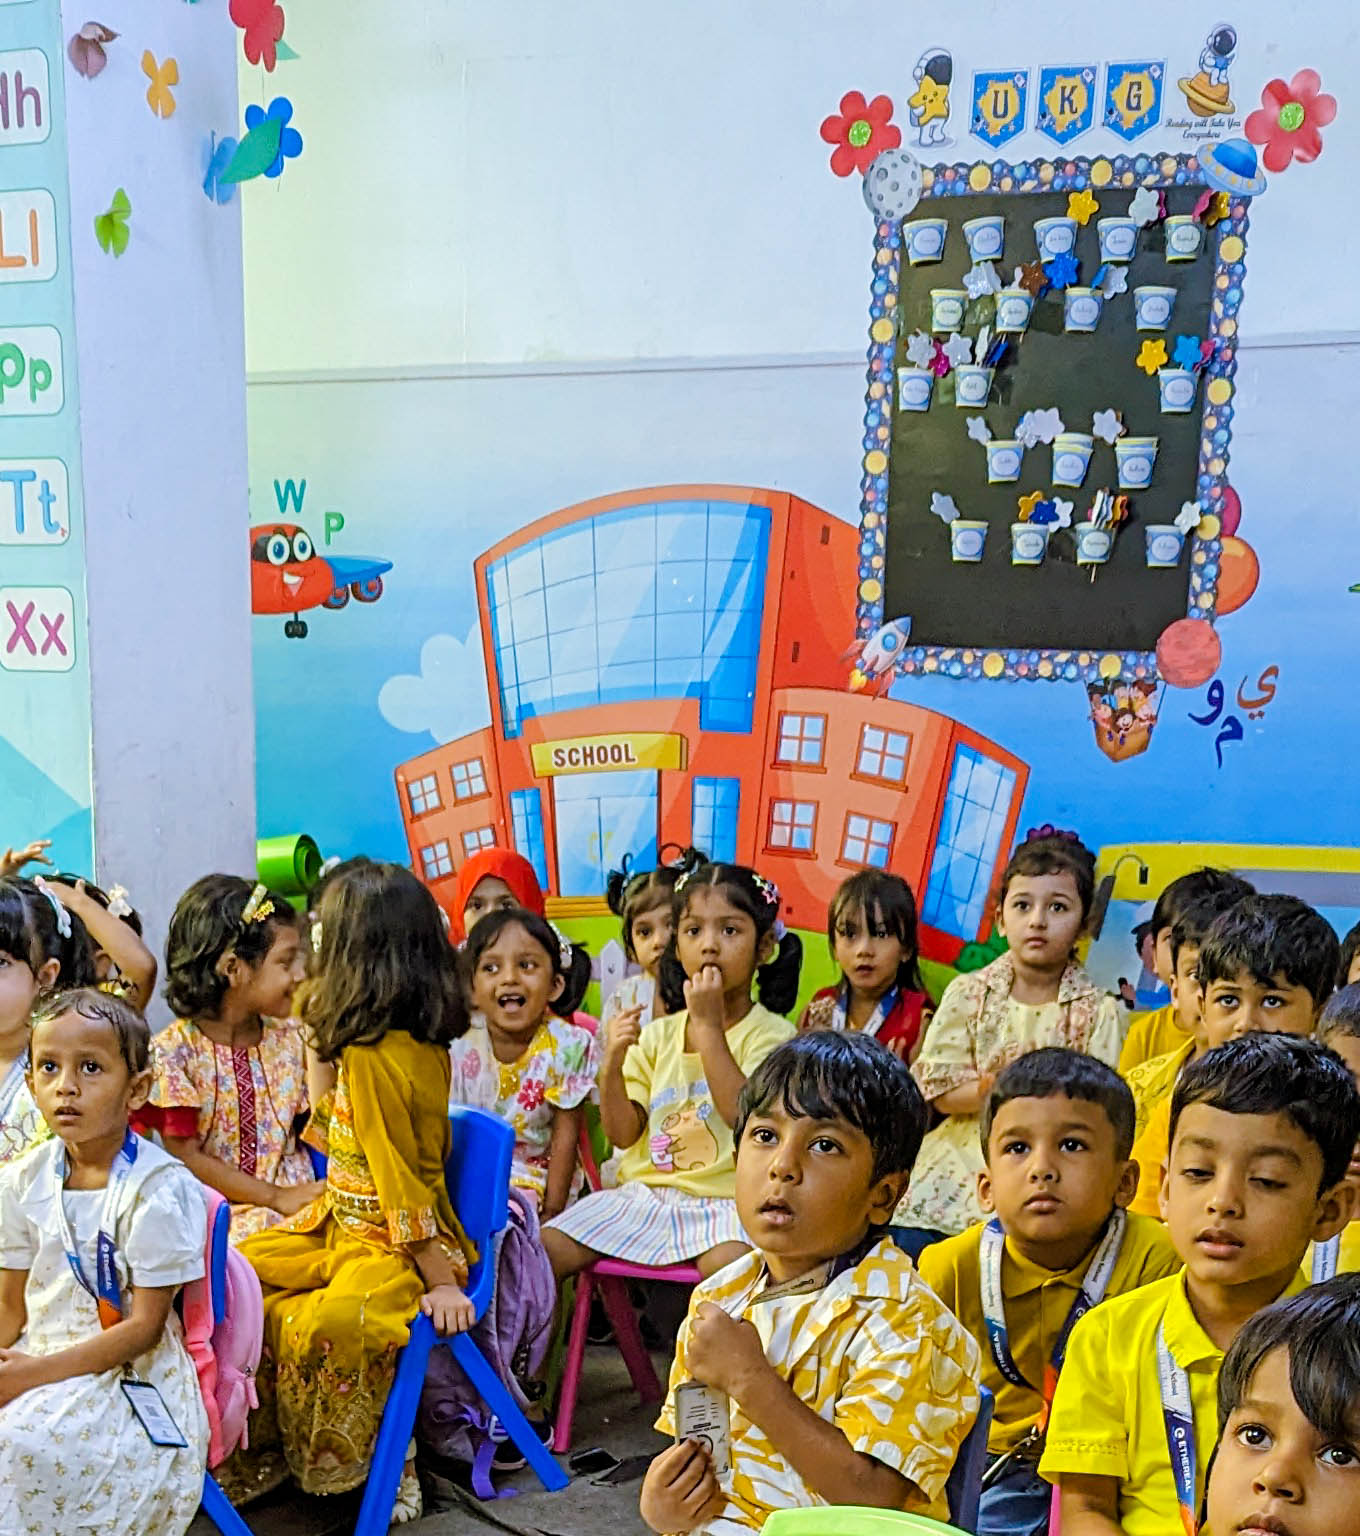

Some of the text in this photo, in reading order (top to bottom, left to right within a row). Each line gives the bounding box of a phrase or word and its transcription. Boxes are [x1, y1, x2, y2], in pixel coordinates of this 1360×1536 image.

[273, 478, 307, 514] W
[325, 511, 345, 546] P
[6, 600, 68, 657] Xx
[552, 743, 636, 768] SCHOOL
[994, 1330, 1012, 1373] ETHEREAL
[1177, 1441, 1193, 1493] ETHEREAL
